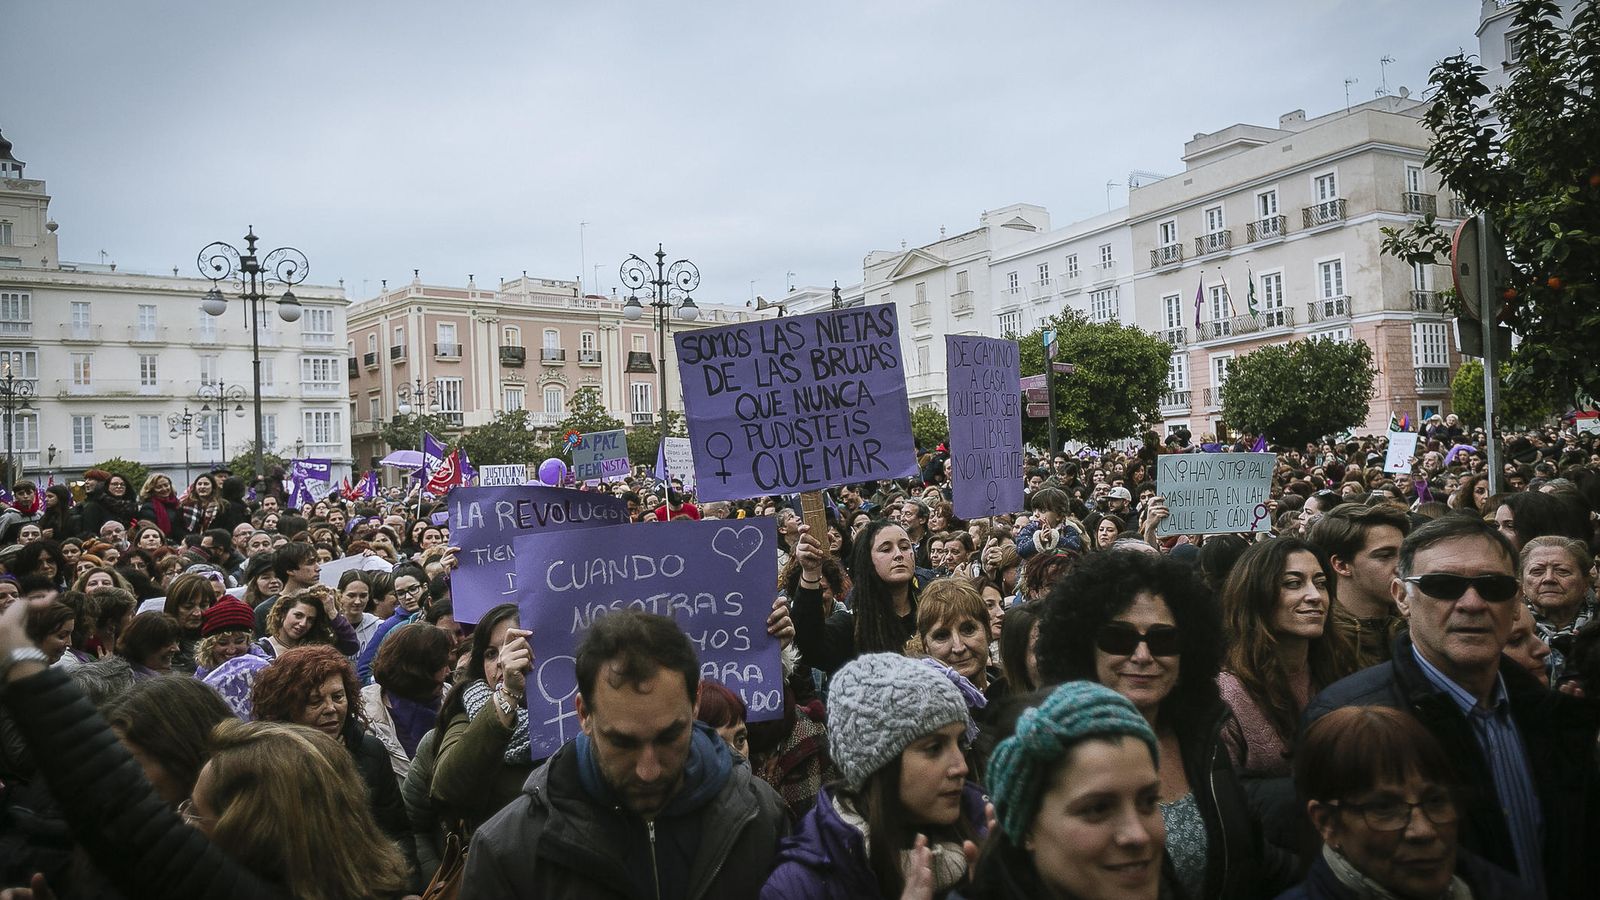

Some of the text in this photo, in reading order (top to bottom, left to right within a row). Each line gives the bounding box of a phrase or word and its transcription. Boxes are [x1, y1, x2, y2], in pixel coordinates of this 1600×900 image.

[681, 307, 893, 364] SOMOS LAS NIETAS
[953, 341, 1013, 368] DE CAMINO
[703, 342, 897, 396] DE LAS BRUJAS
[970, 369, 978, 389] A
[982, 369, 1006, 392] CASA
[735, 380, 875, 421] QUE NUNCA
[953, 391, 999, 416] QUIERO
[1001, 393, 1019, 416] SER
[593, 432, 619, 451] PAZ
[740, 410, 871, 451] PUDISTEIS
[578, 458, 629, 477] FEMINISTA
[594, 453, 604, 461] ES
[955, 452, 1023, 480] NO VALIENTE
[485, 466, 525, 478] JUSTICIA YA
[1189, 460, 1213, 482] HAY
[1226, 486, 1240, 505] EN
[1246, 487, 1263, 504] LAH
[456, 501, 486, 530] LA
[1206, 509, 1218, 530] DE
[546, 554, 685, 592] CUANDO
[700, 662, 764, 684] ARA
